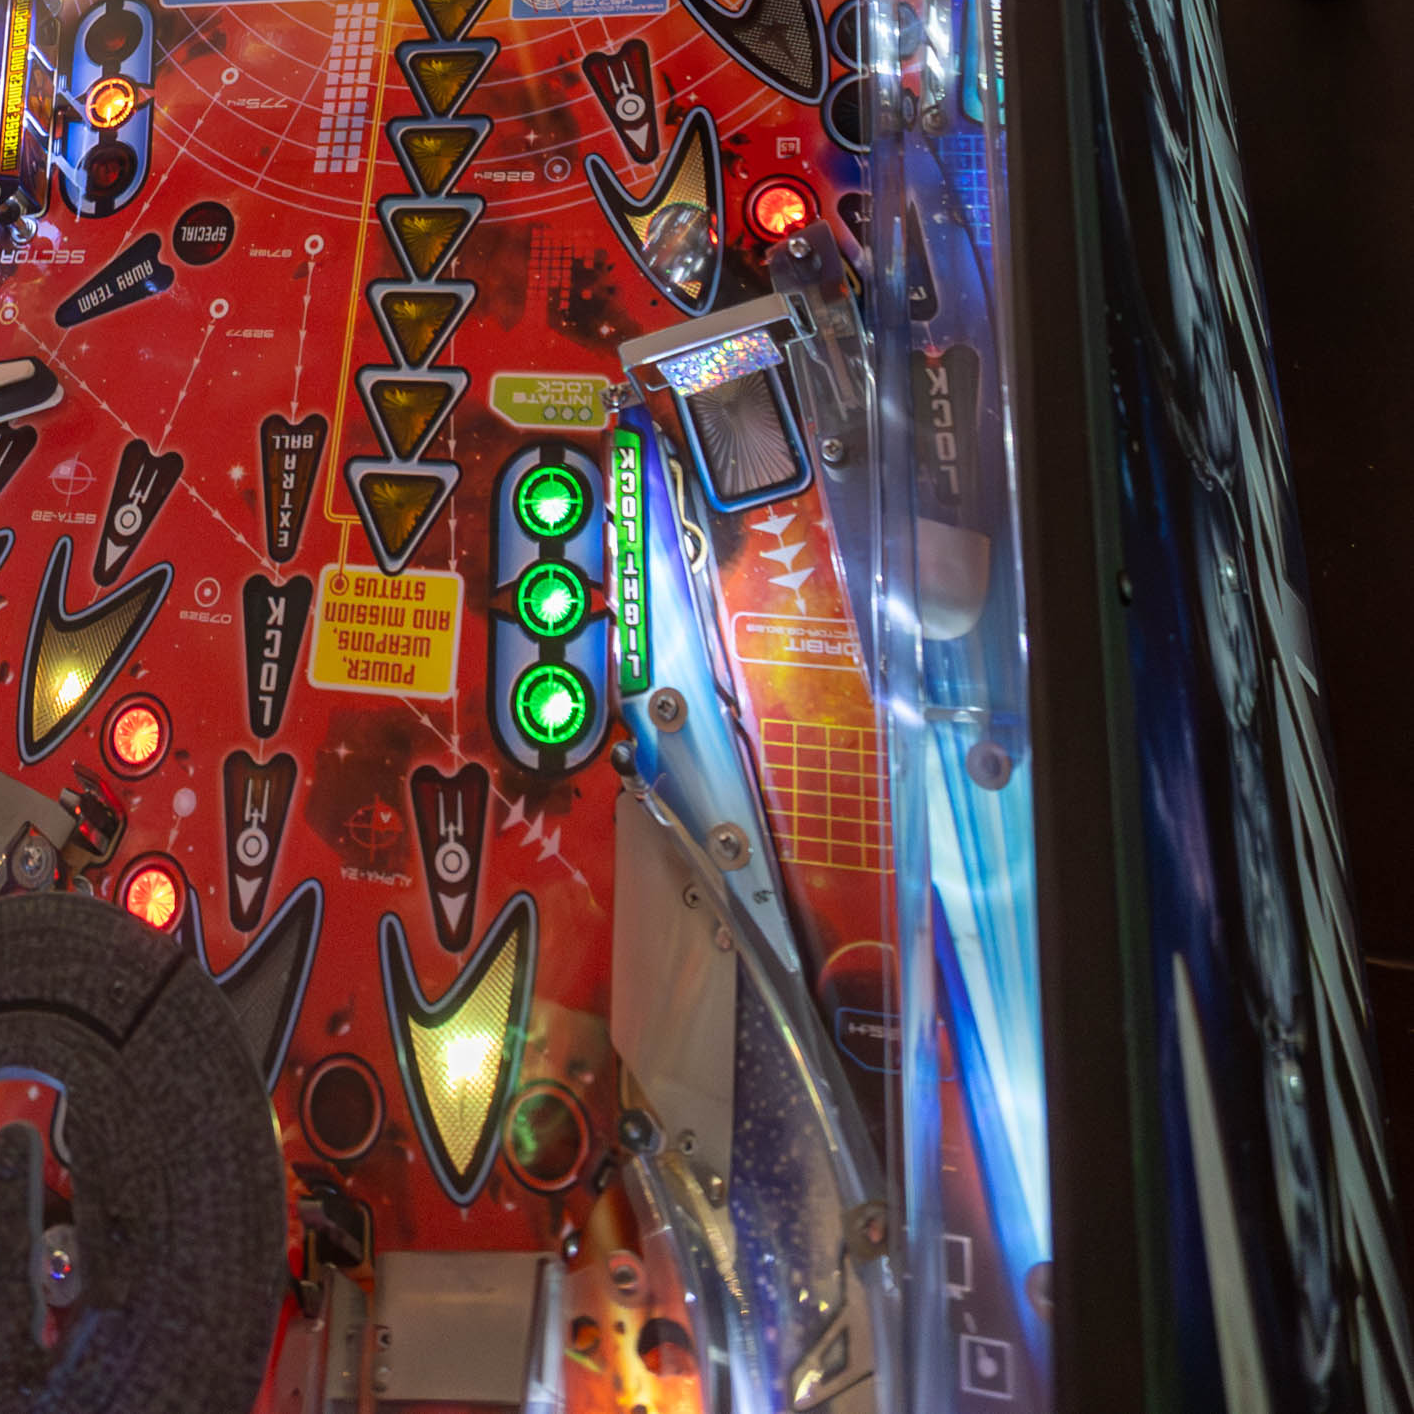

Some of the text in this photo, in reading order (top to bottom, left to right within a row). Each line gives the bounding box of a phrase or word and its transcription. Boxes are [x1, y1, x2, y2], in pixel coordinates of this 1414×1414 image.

[10, 48, 26, 72] AND
[6, 73, 24, 114] POWER
[2, 114, 20, 170] INCREASE
[180, 226, 227, 242] SPECIAL
[1, 249, 86, 264] SECTOR
[76, 259, 154, 314] AWAY TEAM
[512, 392, 592, 404] INITIATE
[536, 381, 593, 393] LOCK
[272, 434, 314, 449] BALL
[926, 366, 959, 494] LOCK
[277, 454, 296, 548] EXTRA
[618, 447, 642, 678] LIGHT LOCK
[354, 577, 426, 601] STATUS
[324, 601, 450, 631] AND MISSION
[332, 628, 430, 658] WEAPONS,
[258, 596, 286, 726] LOCK
[342, 656, 415, 685] POWER,
